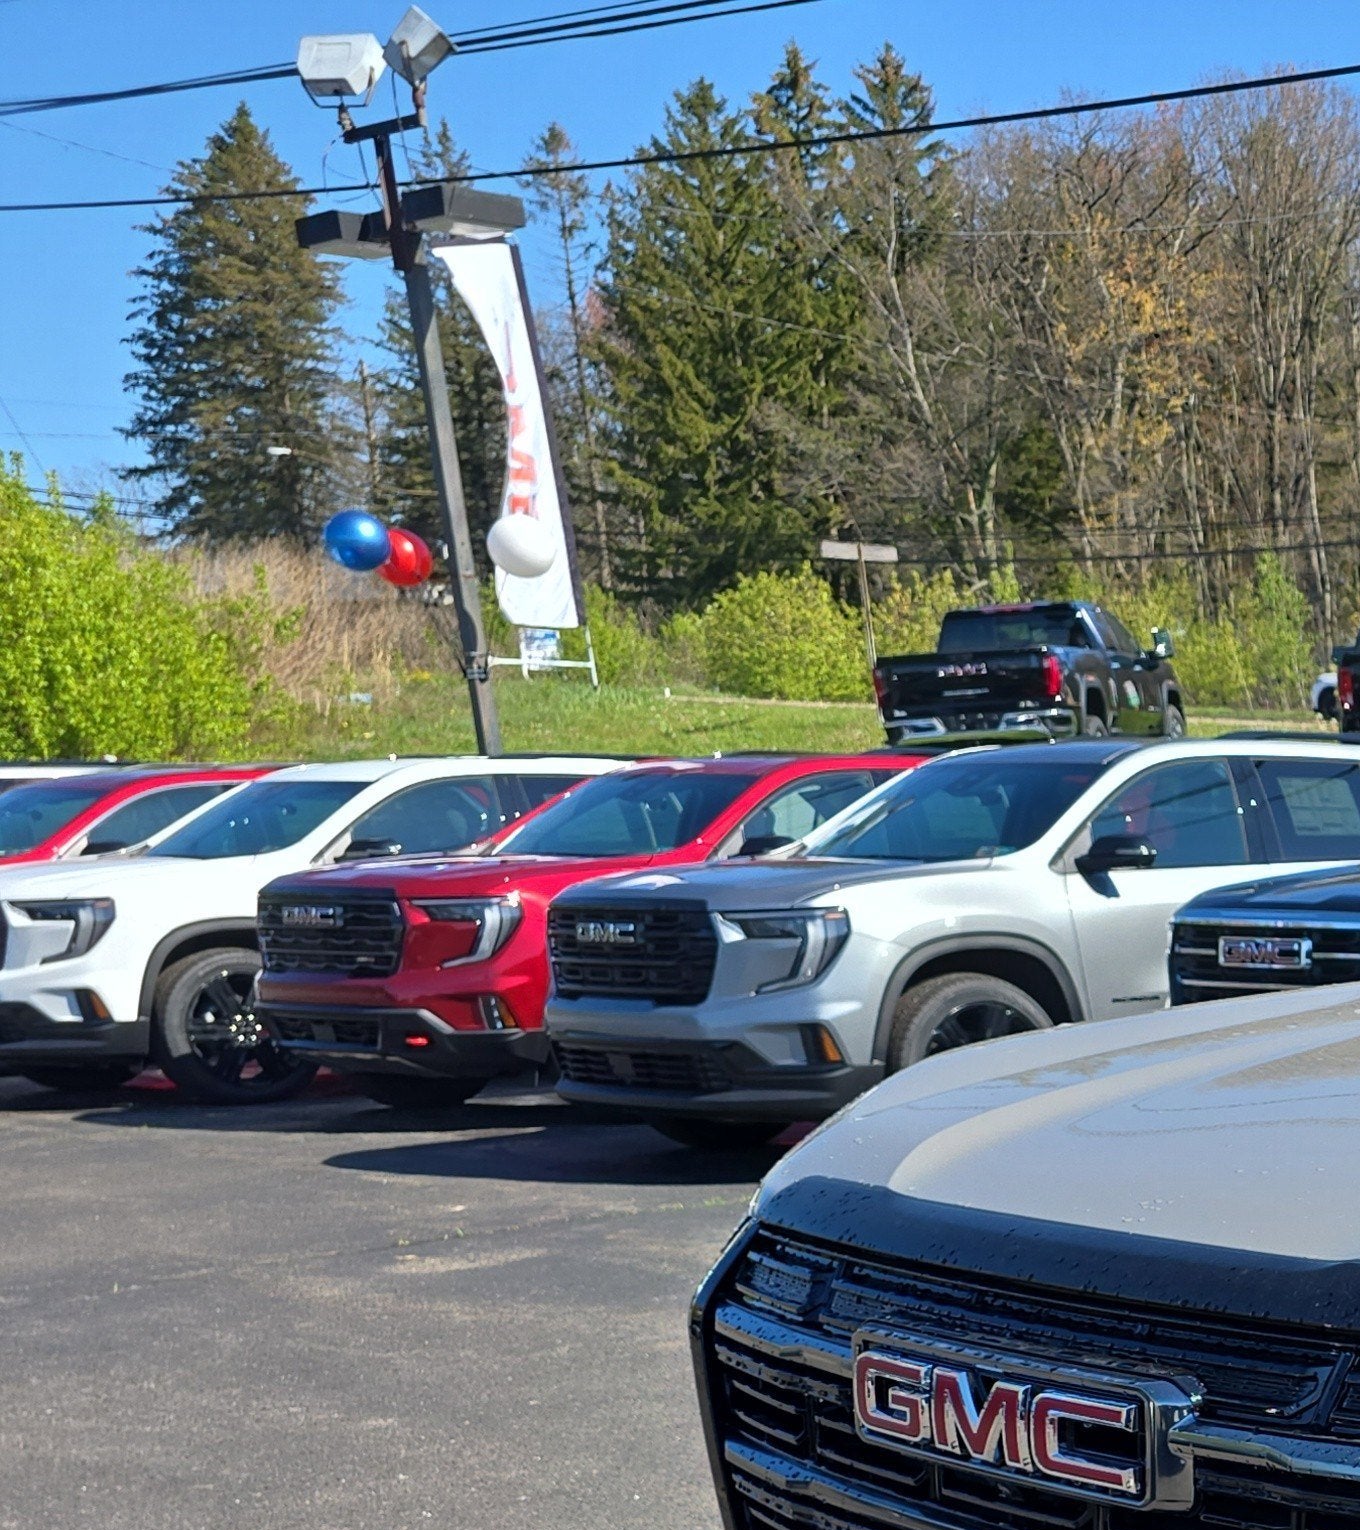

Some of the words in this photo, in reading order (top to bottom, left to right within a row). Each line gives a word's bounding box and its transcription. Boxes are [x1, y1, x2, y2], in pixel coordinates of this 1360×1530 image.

[575, 922, 635, 942] GMC
[1223, 941, 1301, 965] GMC
[853, 1351, 1140, 1494] GMC
